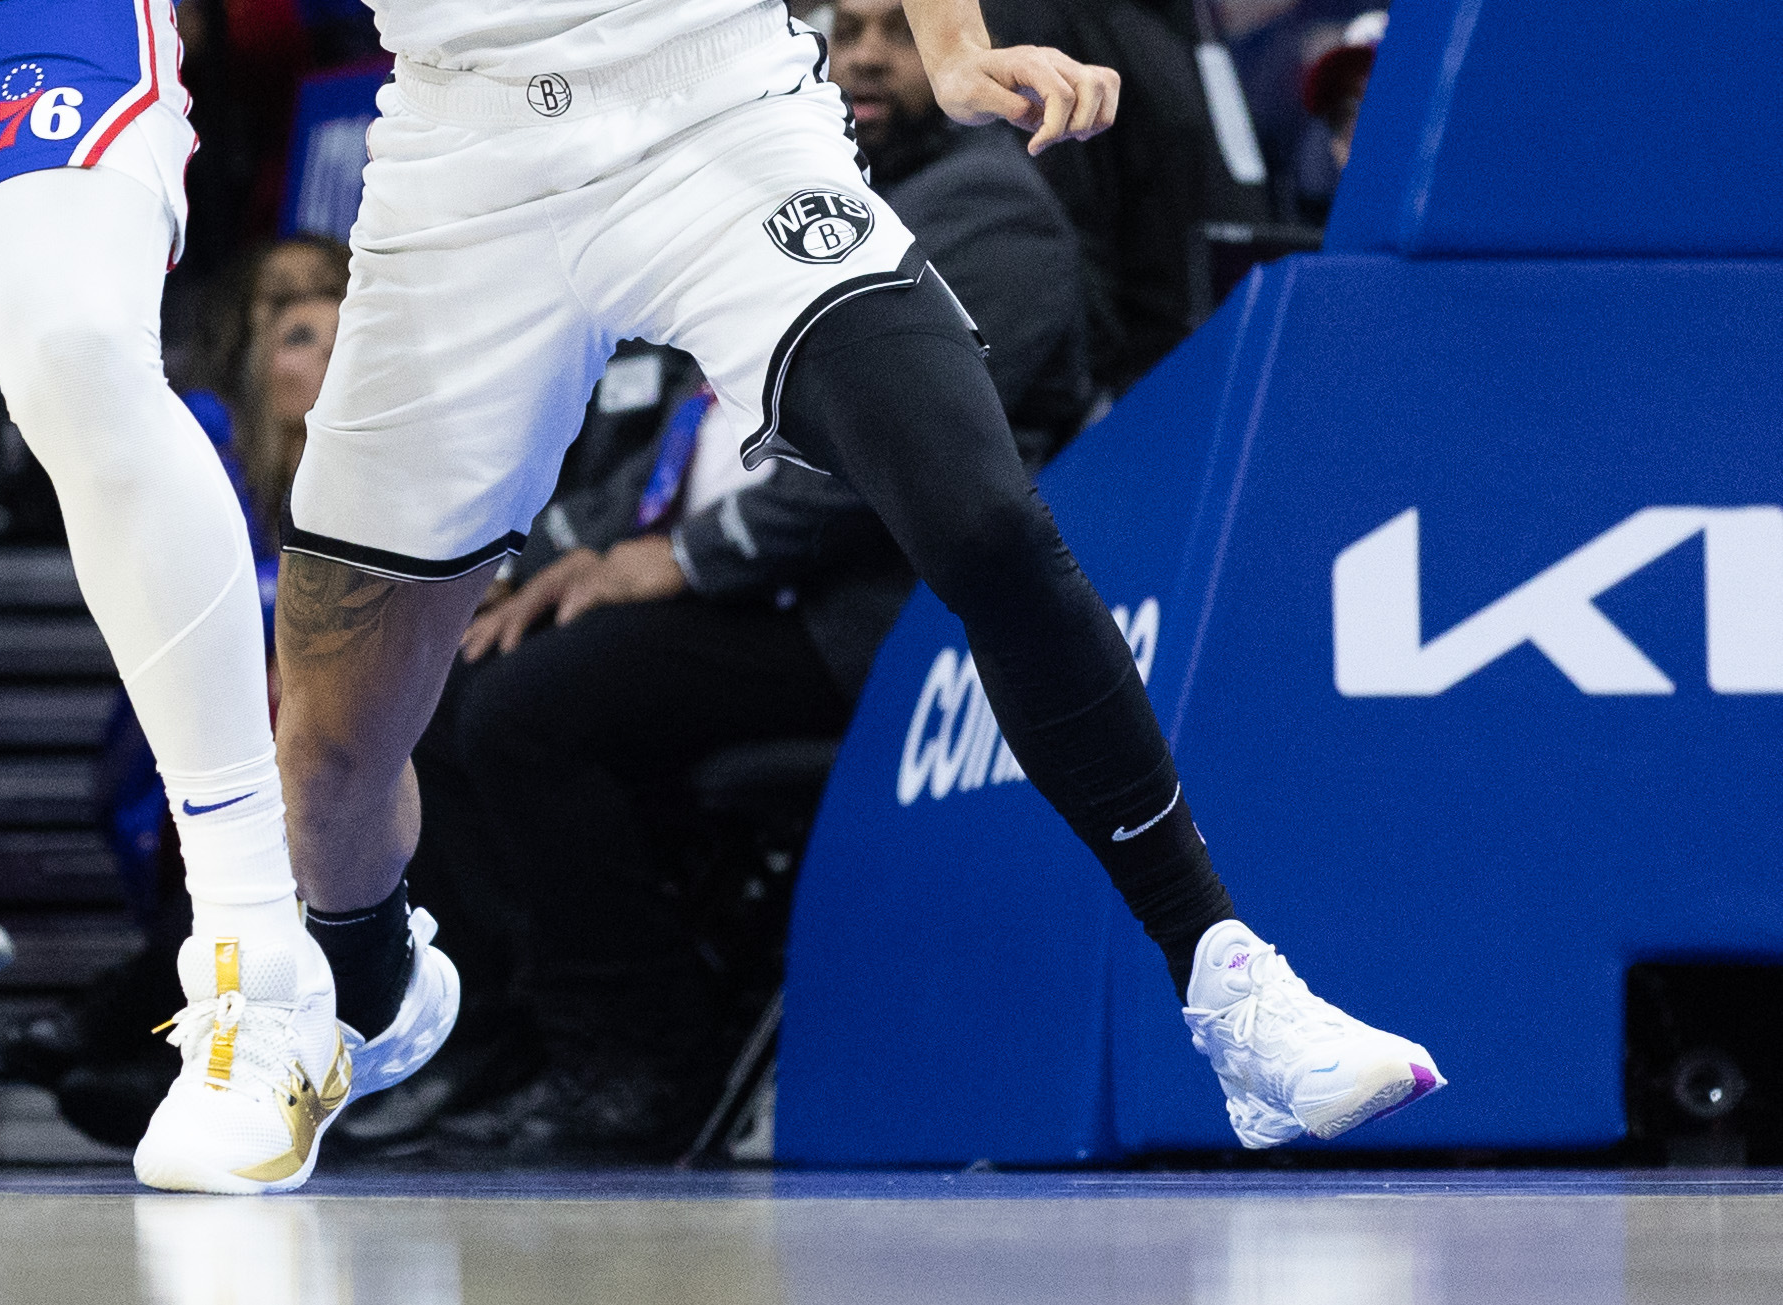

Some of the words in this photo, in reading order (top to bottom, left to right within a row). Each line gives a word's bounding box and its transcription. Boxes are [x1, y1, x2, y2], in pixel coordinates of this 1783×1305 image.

[540, 78, 558, 111] B
[773, 192, 869, 244] NETS
[818, 223, 841, 250] B
